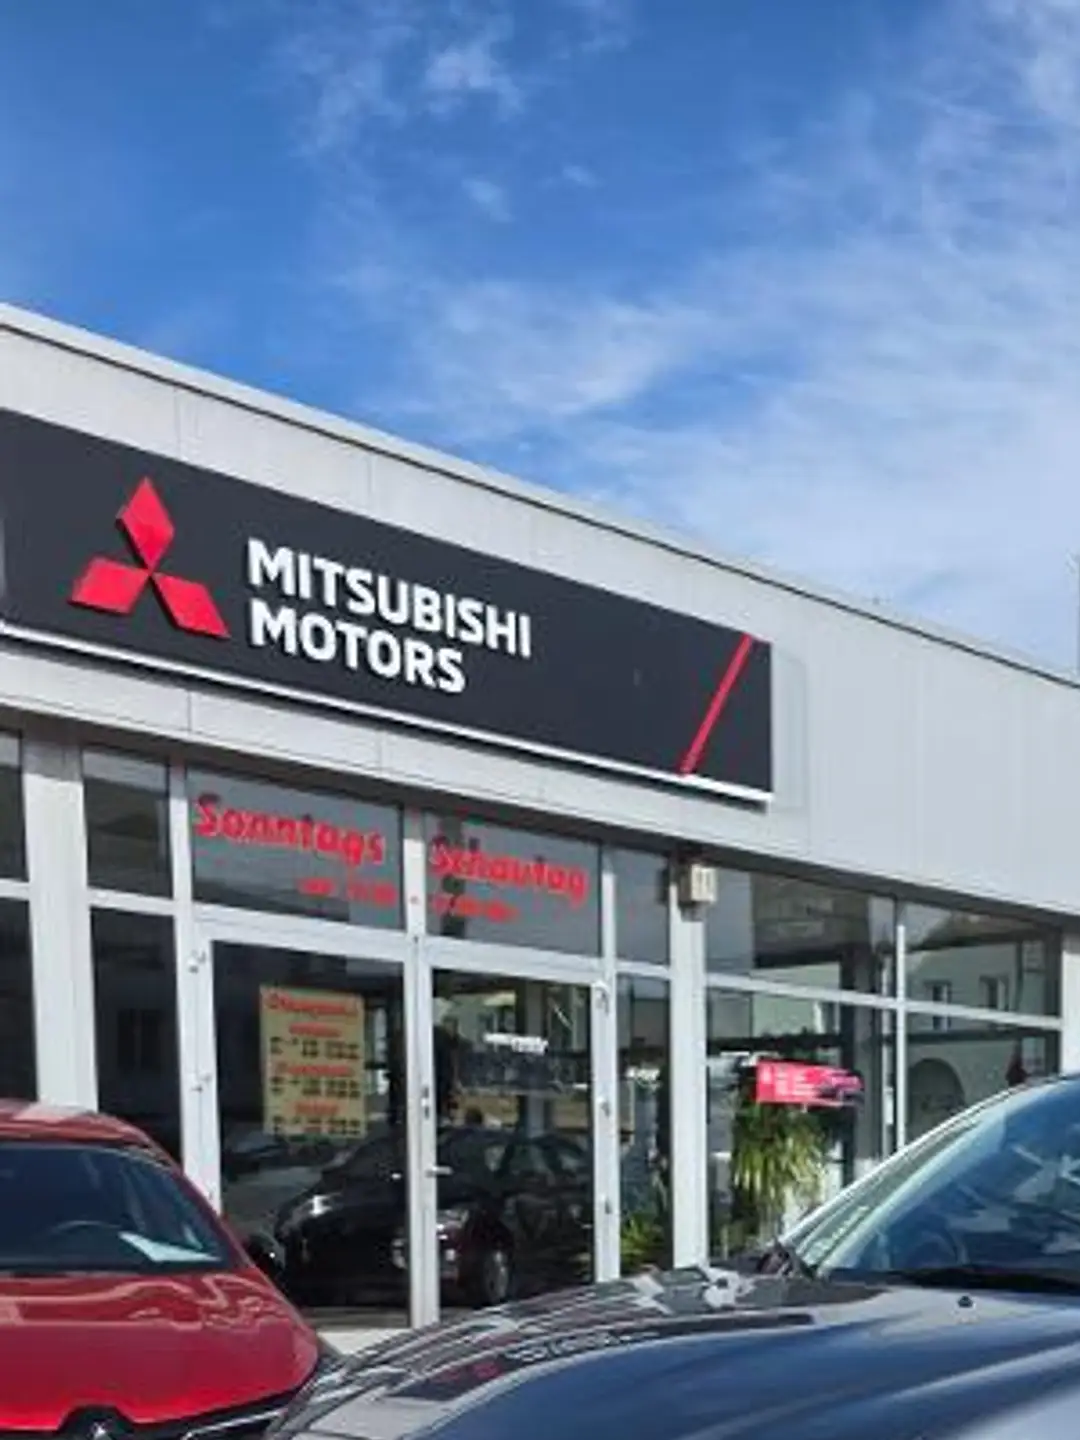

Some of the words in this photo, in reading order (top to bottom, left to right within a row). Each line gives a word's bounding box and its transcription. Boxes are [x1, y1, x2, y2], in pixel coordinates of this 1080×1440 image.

[247, 537, 532, 658] MITSUBISHI
[250, 601, 467, 693] MOTORS
[194, 794, 386, 867] Sonntags
